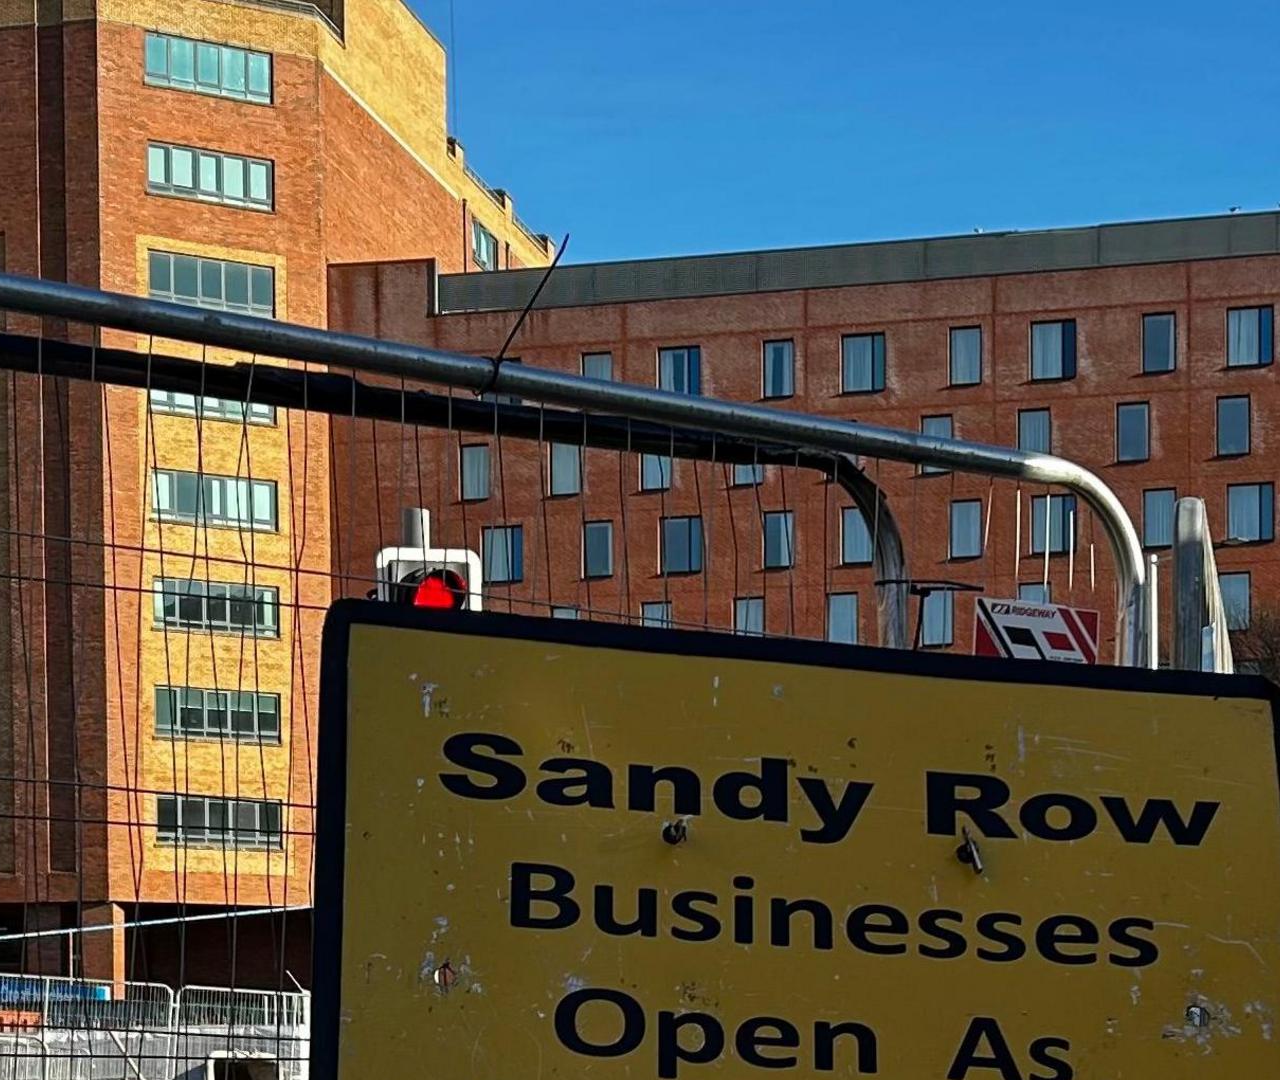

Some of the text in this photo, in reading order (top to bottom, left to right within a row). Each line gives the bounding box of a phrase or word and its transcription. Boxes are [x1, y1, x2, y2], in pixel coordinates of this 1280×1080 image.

[1011, 605, 1057, 619] RIDGEWAY
[438, 731, 1221, 847] Sandy Row
[509, 861, 1160, 967] Businesses
[554, 987, 879, 1080] Open
